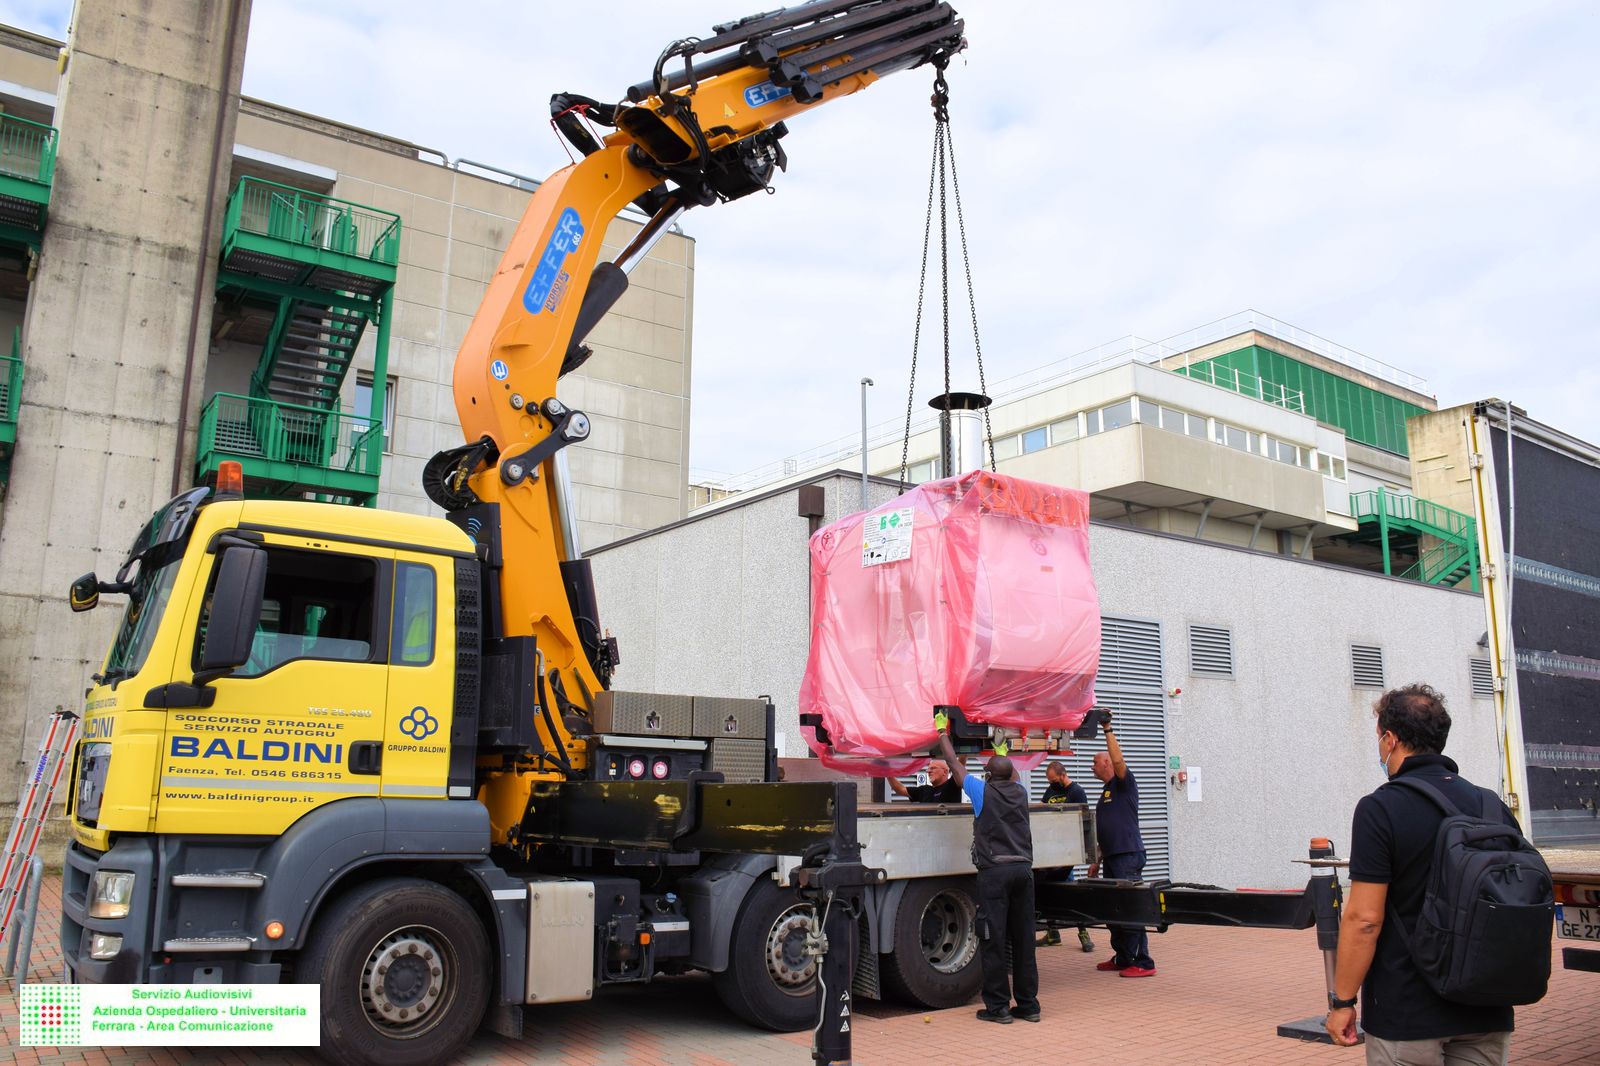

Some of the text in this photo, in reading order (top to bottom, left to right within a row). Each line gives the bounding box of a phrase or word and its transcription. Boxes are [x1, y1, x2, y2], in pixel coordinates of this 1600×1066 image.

[530, 213, 577, 305] EFFER
[545, 269, 568, 311] HYDROTEC
[175, 714, 345, 730] SOCCORSO STRADALE
[183, 723, 336, 737] SERVIZIO AUTOGRU
[170, 736, 343, 764] BALDINI
[387, 744, 447, 754] GRUPPO BALDINI
[168, 766, 342, 779] Faenza, Tel. 0546 686315
[165, 792, 315, 803] www.baldinigroup.it
[541, 913, 585, 928] MAN
[1579, 909, 1590, 923] N
[1562, 922, 1582, 938] GE
